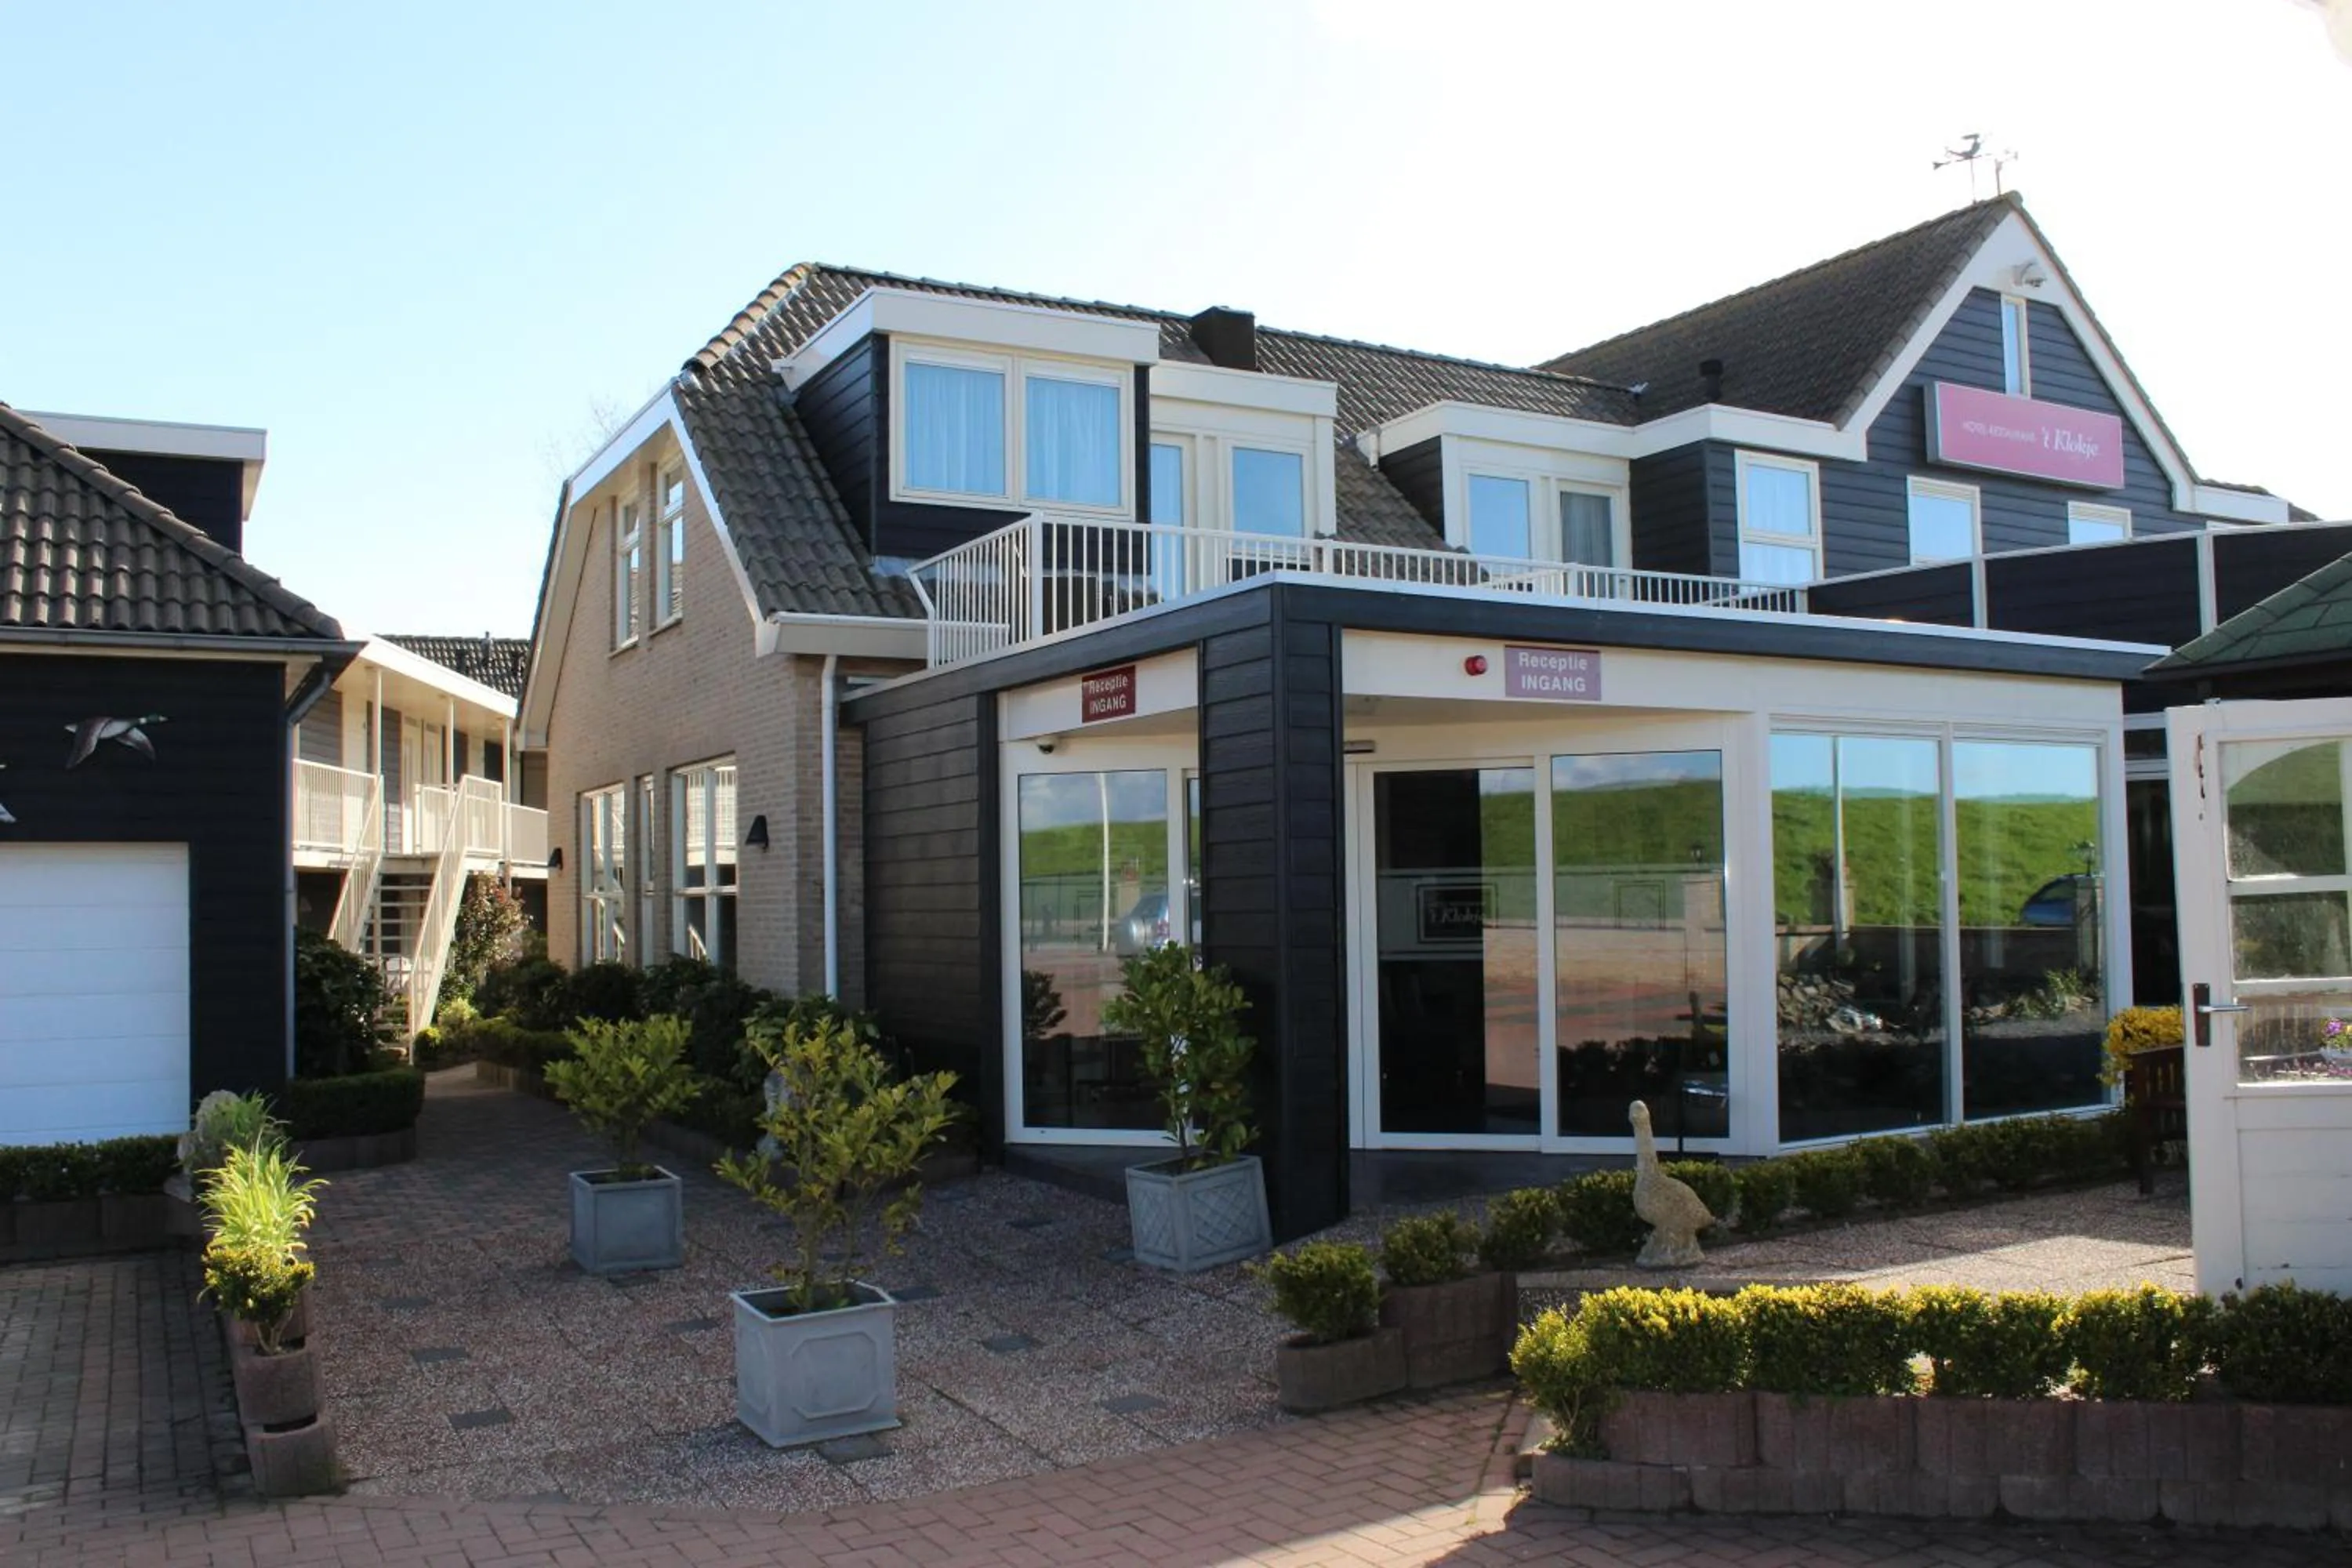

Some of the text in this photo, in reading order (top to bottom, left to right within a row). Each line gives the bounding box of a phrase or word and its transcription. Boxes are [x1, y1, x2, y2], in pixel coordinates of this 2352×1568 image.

[2054, 429, 2100, 458] Klokje
[1519, 652, 1588, 672] Receptie
[1089, 674, 1128, 694] Receptie
[1521, 675, 1586, 691] INGANG
[1089, 694, 1127, 714] INGANG
